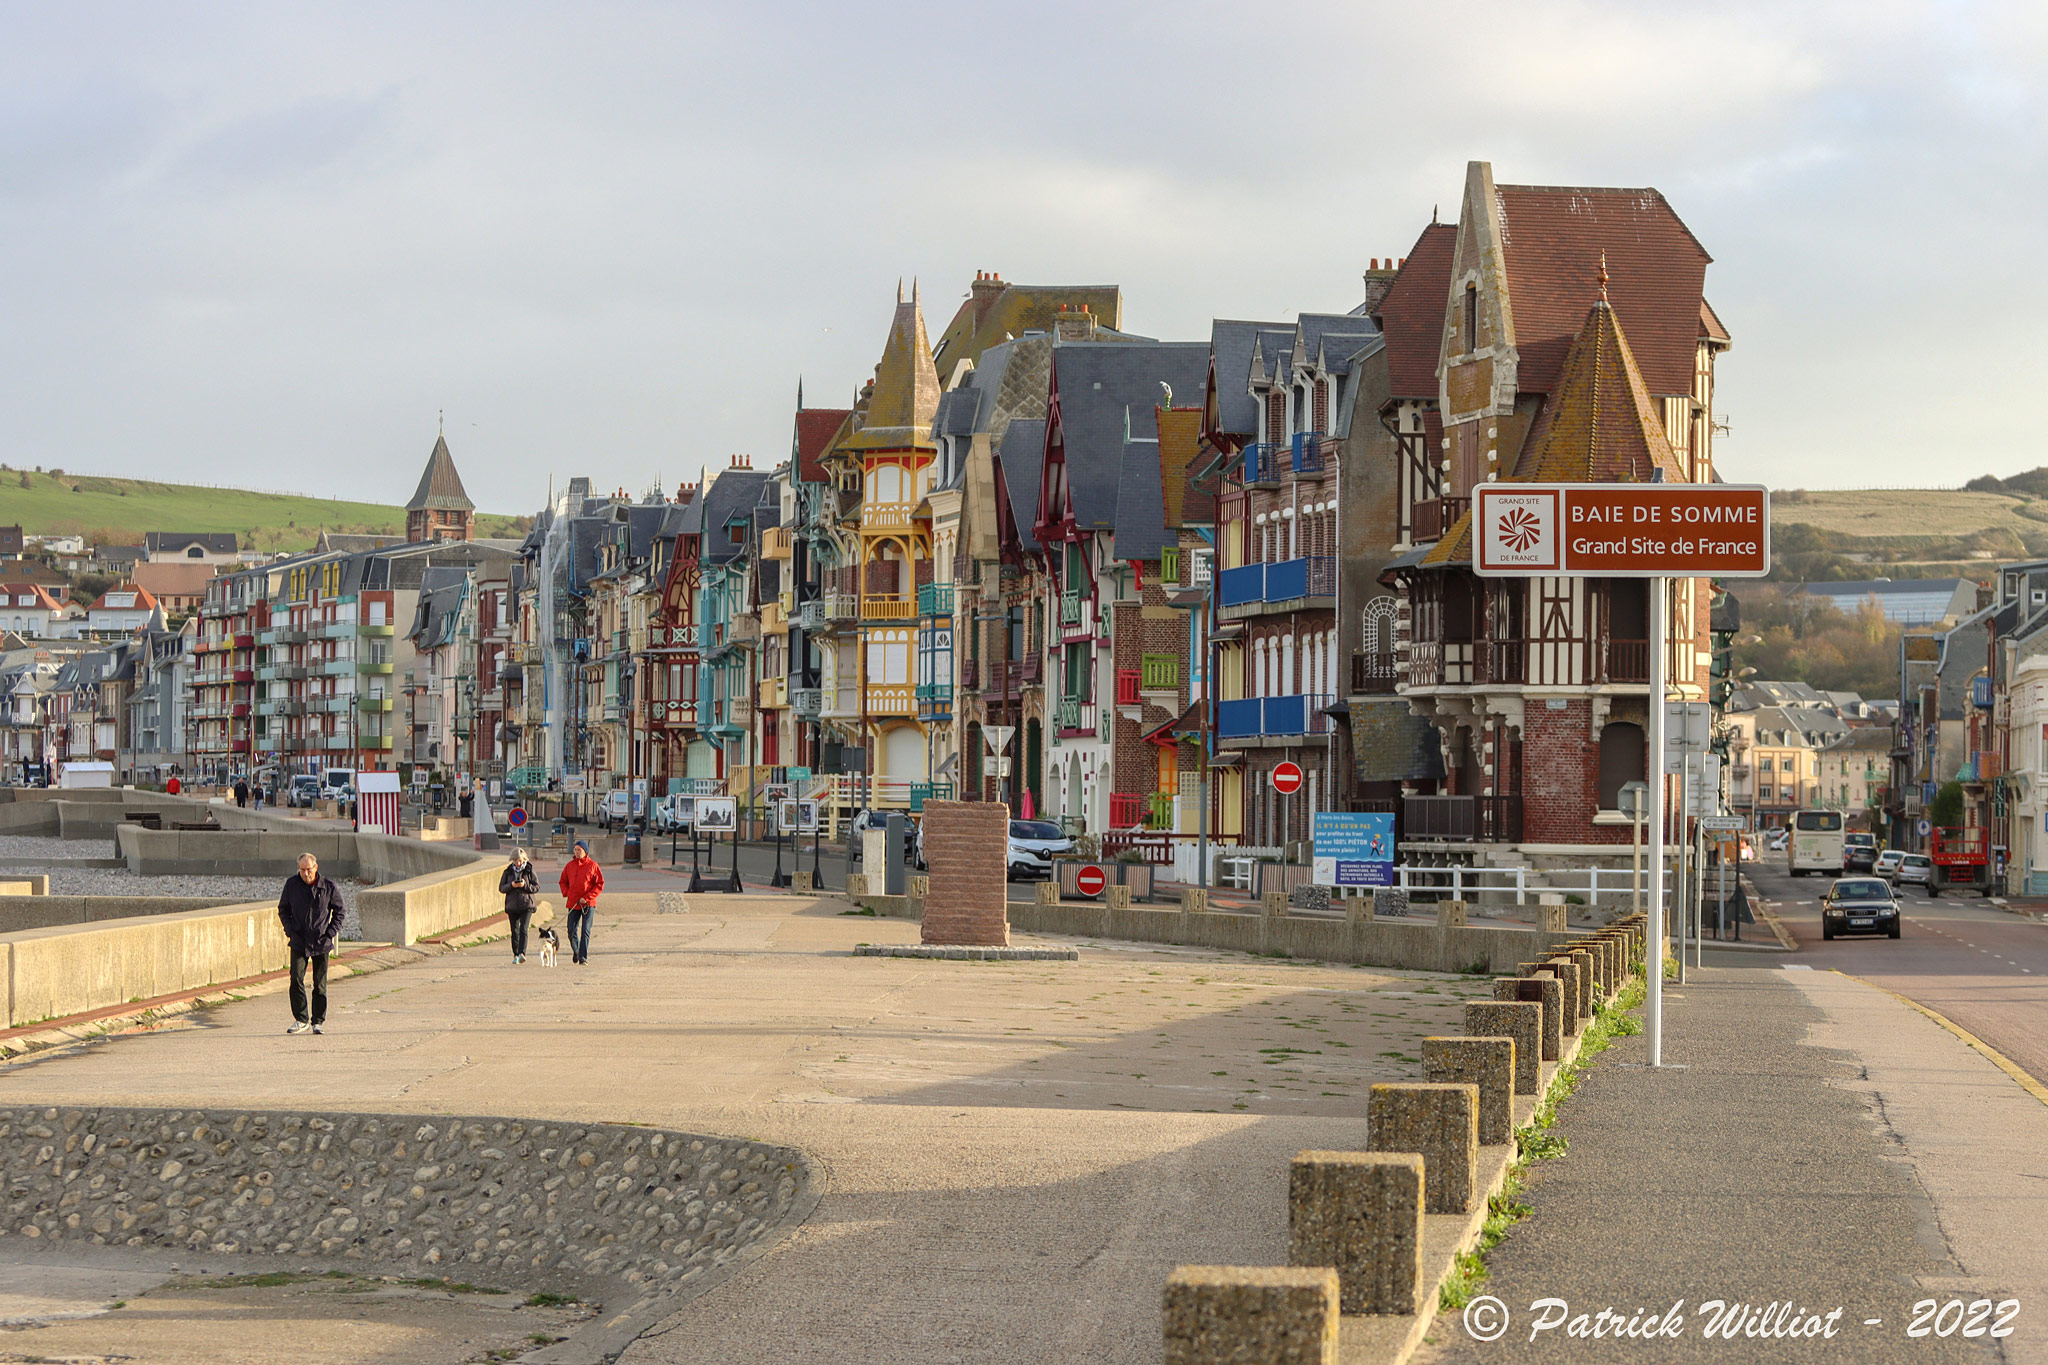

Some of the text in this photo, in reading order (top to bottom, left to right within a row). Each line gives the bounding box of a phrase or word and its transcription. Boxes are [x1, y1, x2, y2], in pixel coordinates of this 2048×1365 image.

[1572, 506, 1757, 523] BAIE DE SOMME
[1572, 536, 1757, 555] Grand Site de France
[1348, 838, 1368, 846] PIÉTON
